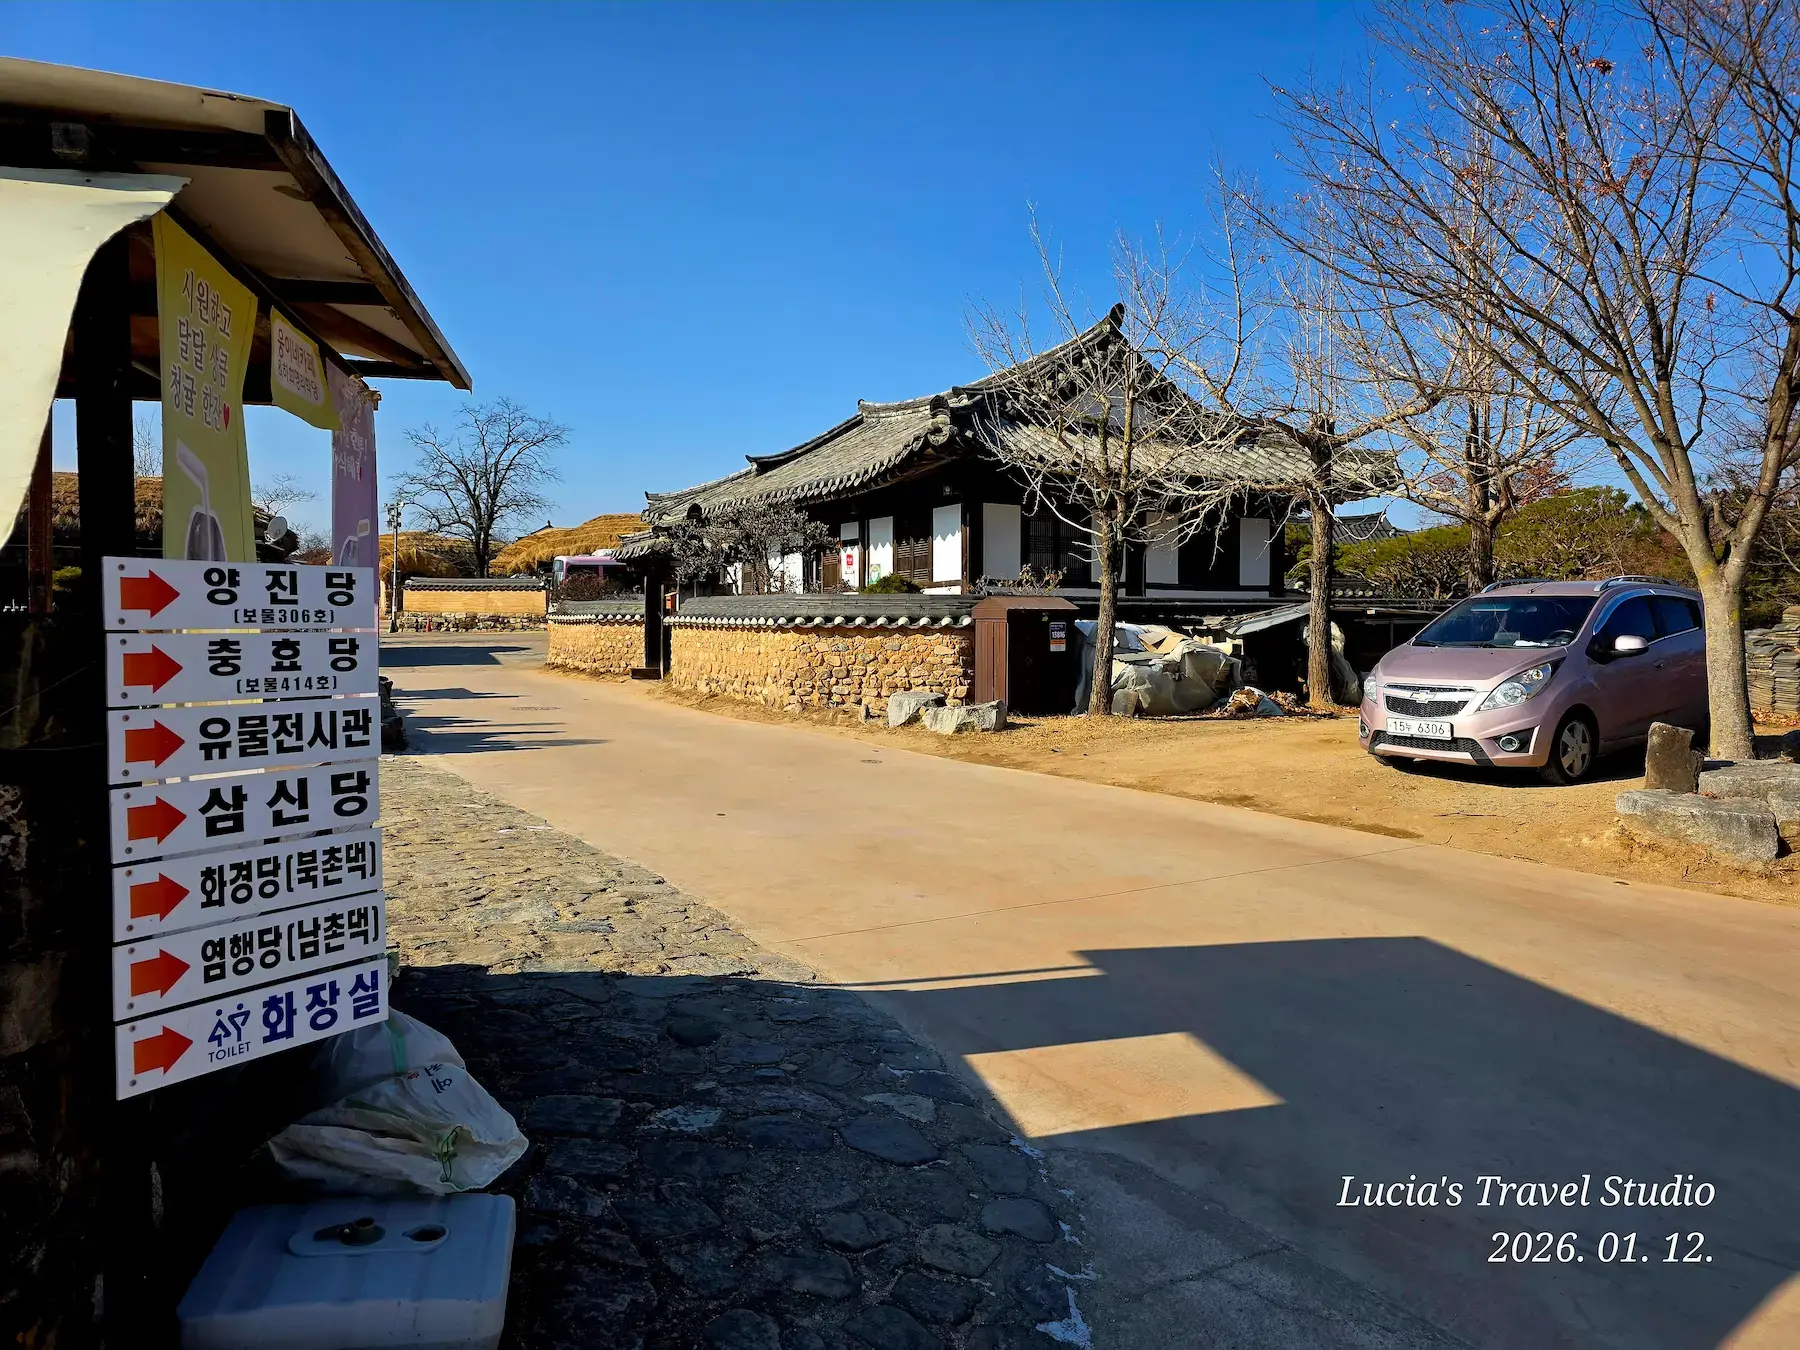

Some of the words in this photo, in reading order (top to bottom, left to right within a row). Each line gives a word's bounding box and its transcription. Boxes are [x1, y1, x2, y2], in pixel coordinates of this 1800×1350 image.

[182, 269, 232, 338] 시원하고
[178, 318, 207, 372] 달달
[209, 343, 229, 389] 상큼
[170, 363, 197, 417] 청귤
[201, 386, 223, 432] 한잔
[234, 608, 334, 624] (보물306호)
[236, 675, 337, 694] (보물414호)
[199, 708, 372, 761] 유물전시관
[1417, 722, 1445, 735] 6306
[200, 841, 377, 909] 화경당(북촌댁)
[262, 969, 380, 1044] 화장실
[208, 1041, 251, 1063] TOILET
